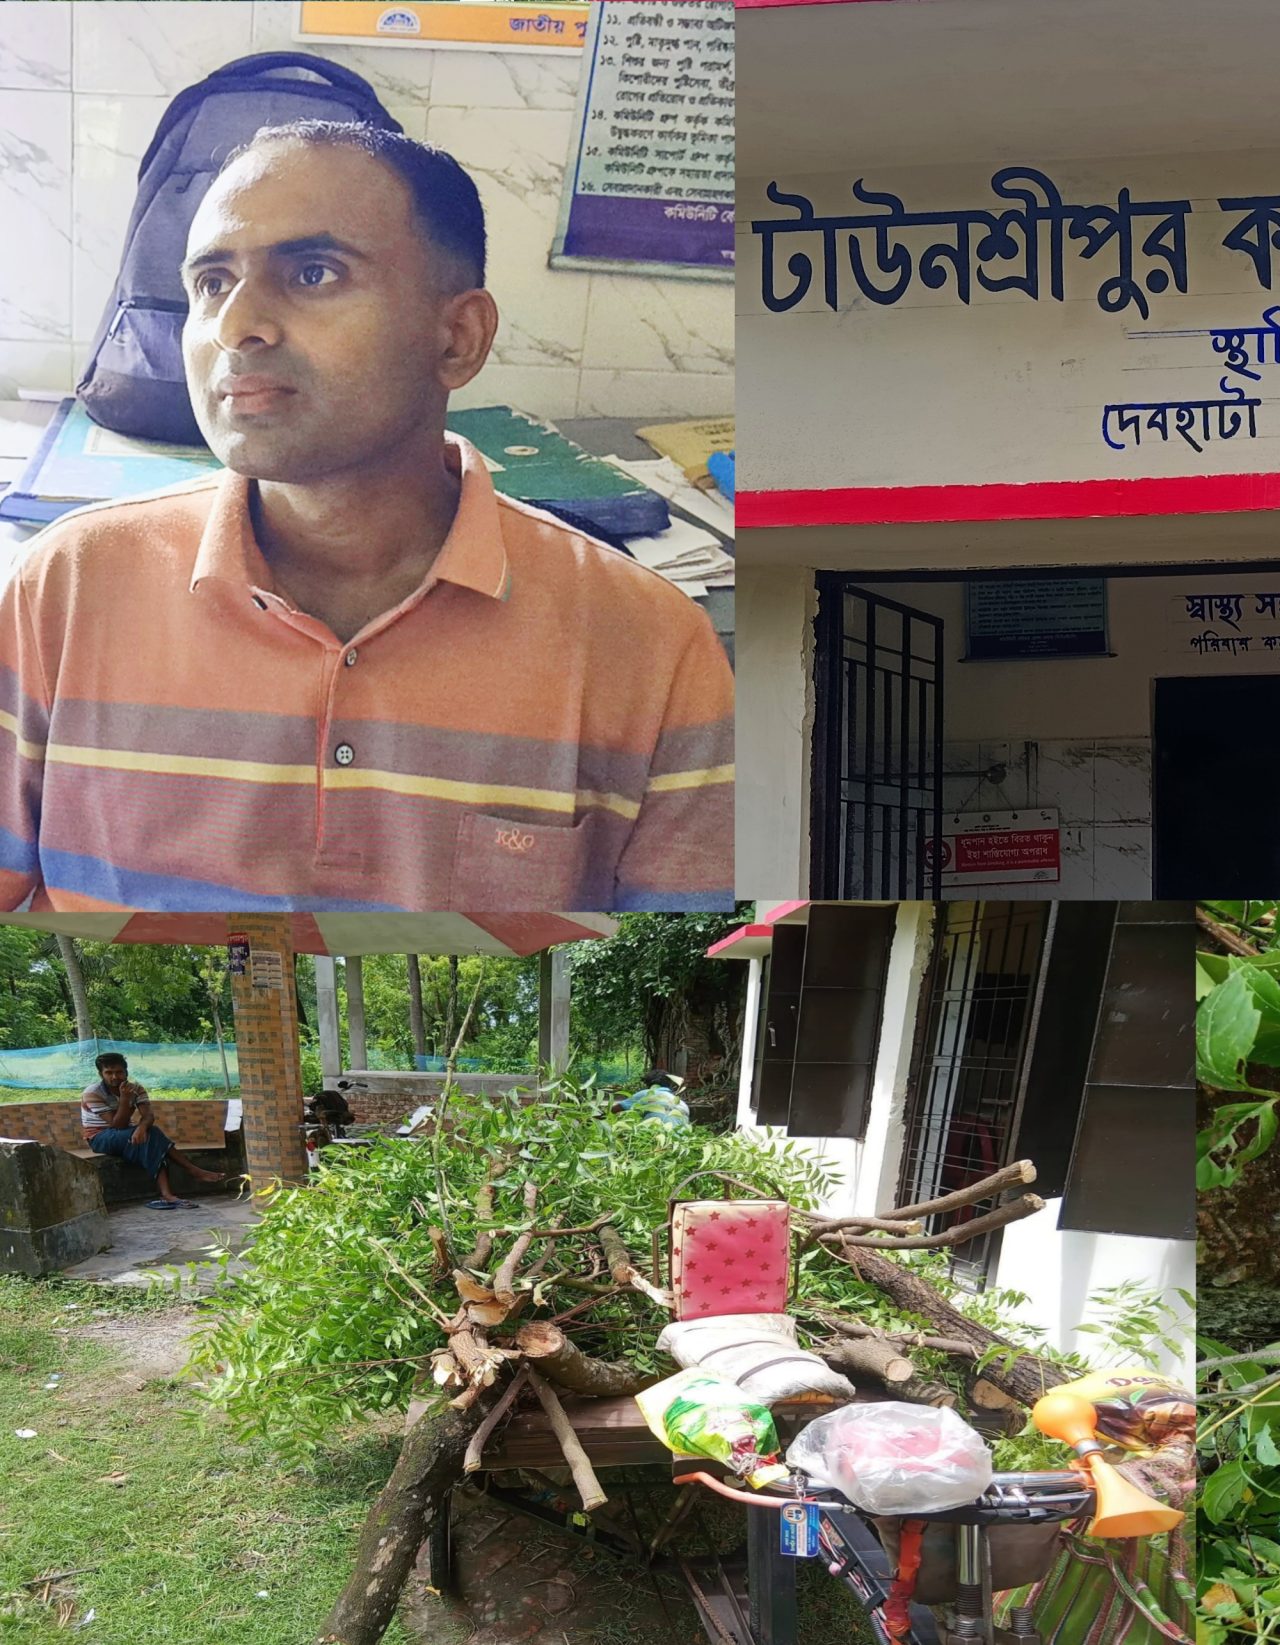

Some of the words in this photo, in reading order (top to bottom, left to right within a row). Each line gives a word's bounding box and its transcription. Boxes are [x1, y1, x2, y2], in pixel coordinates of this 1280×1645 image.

[509, 14, 565, 34] জাতীয়
[613, 108, 655, 122] কমিউনিটি
[608, 144, 649, 158] কমিউনিটি
[604, 162, 645, 175] কমিউনিটি
[664, 203, 719, 222] কমিউনিটি
[752, 167, 1193, 321] টাউনশ্রীপুর
[1103, 377, 1263, 453] দেবহাটা
[1185, 594, 1245, 632] স্বাস্থ্য
[1190, 629, 1252, 656] পরিবার
[1011, 833, 1031, 844] বিরত
[1022, 847, 1048, 857] অপরাধ
